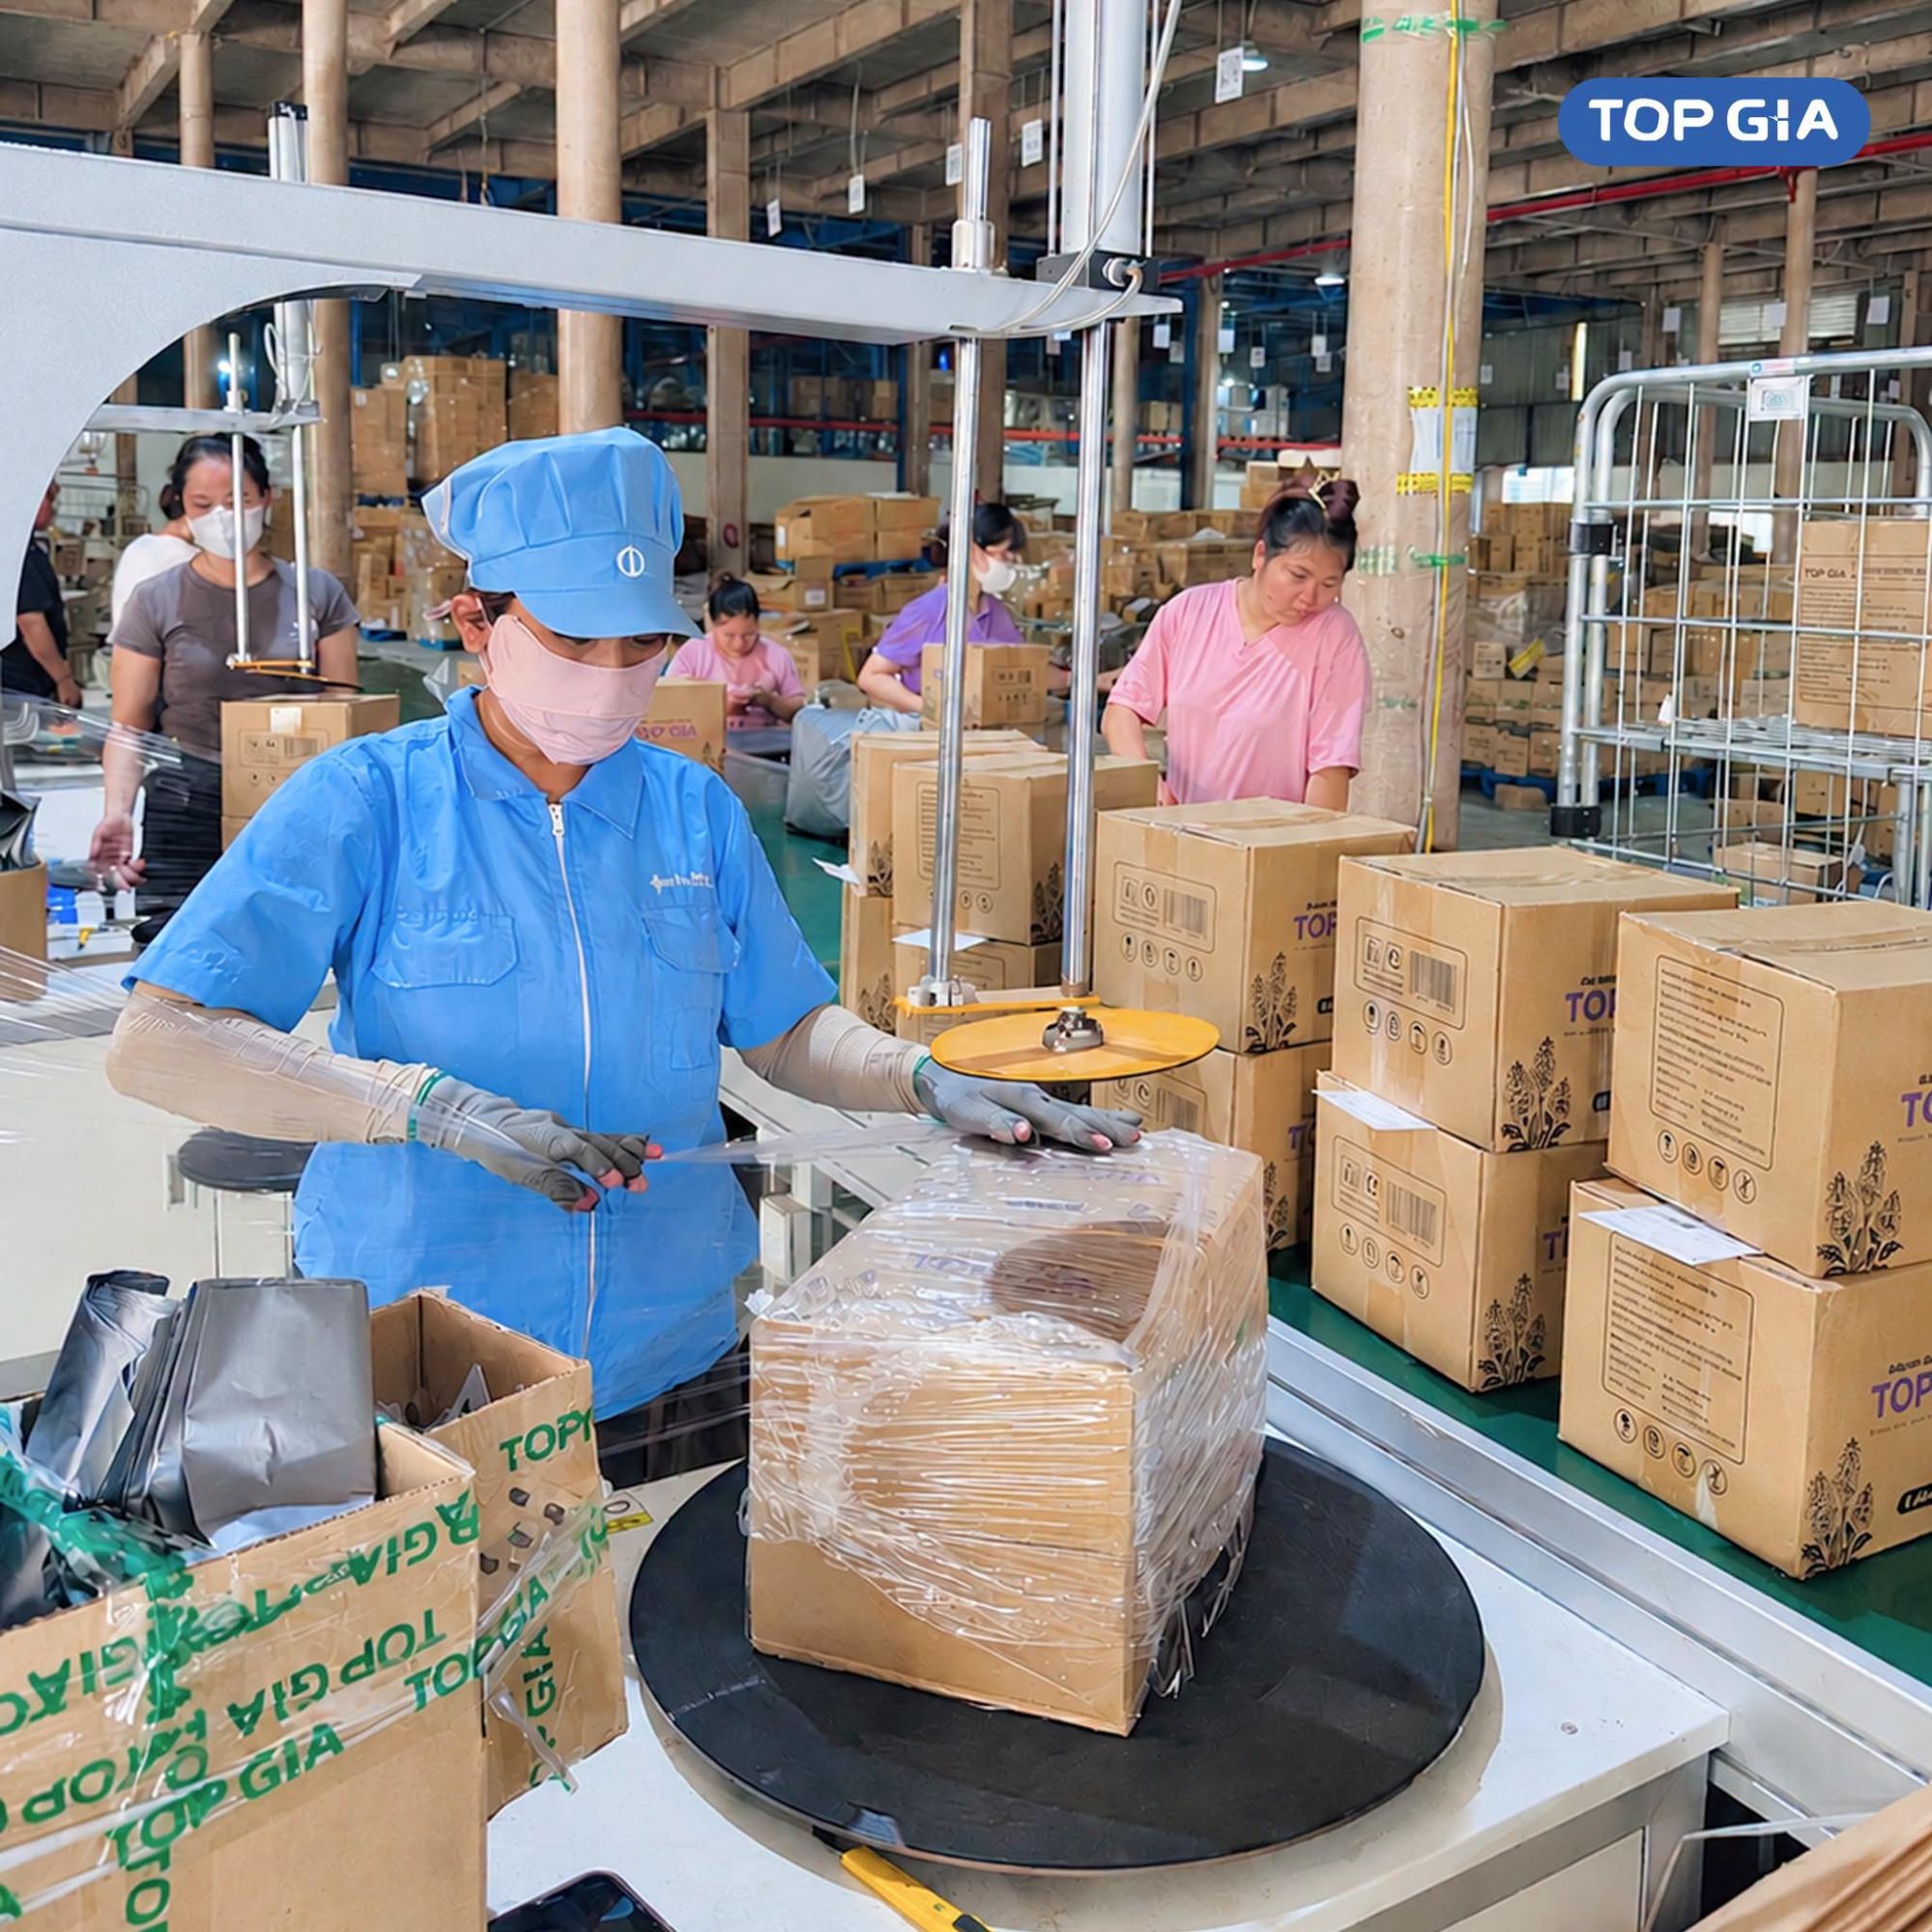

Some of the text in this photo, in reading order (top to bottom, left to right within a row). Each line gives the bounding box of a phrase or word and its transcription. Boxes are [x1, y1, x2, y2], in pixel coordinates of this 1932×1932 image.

[340, 1608, 447, 1687] TOP
[226, 1675, 331, 1738] GIA
[239, 1723, 344, 1800] GIA
